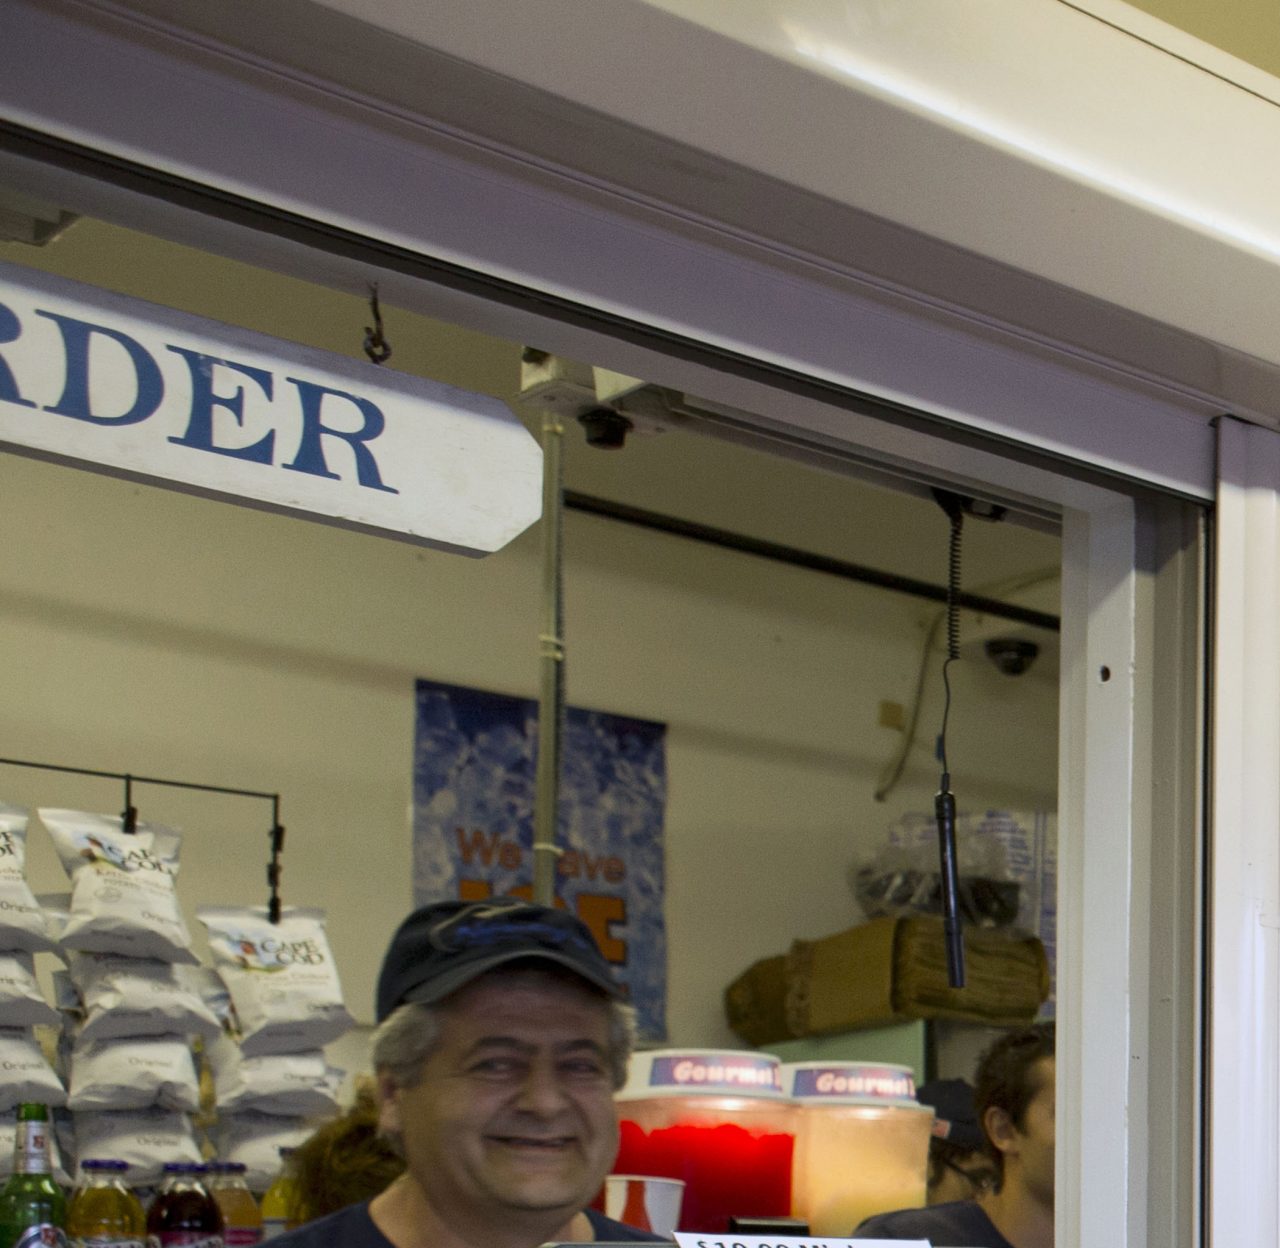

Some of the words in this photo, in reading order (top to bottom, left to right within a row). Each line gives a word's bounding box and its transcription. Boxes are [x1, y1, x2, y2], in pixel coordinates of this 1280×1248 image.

[0, 303, 399, 494] DER
[456, 827, 522, 870] We
[556, 850, 626, 884] ave
[275, 950, 325, 966] COD
